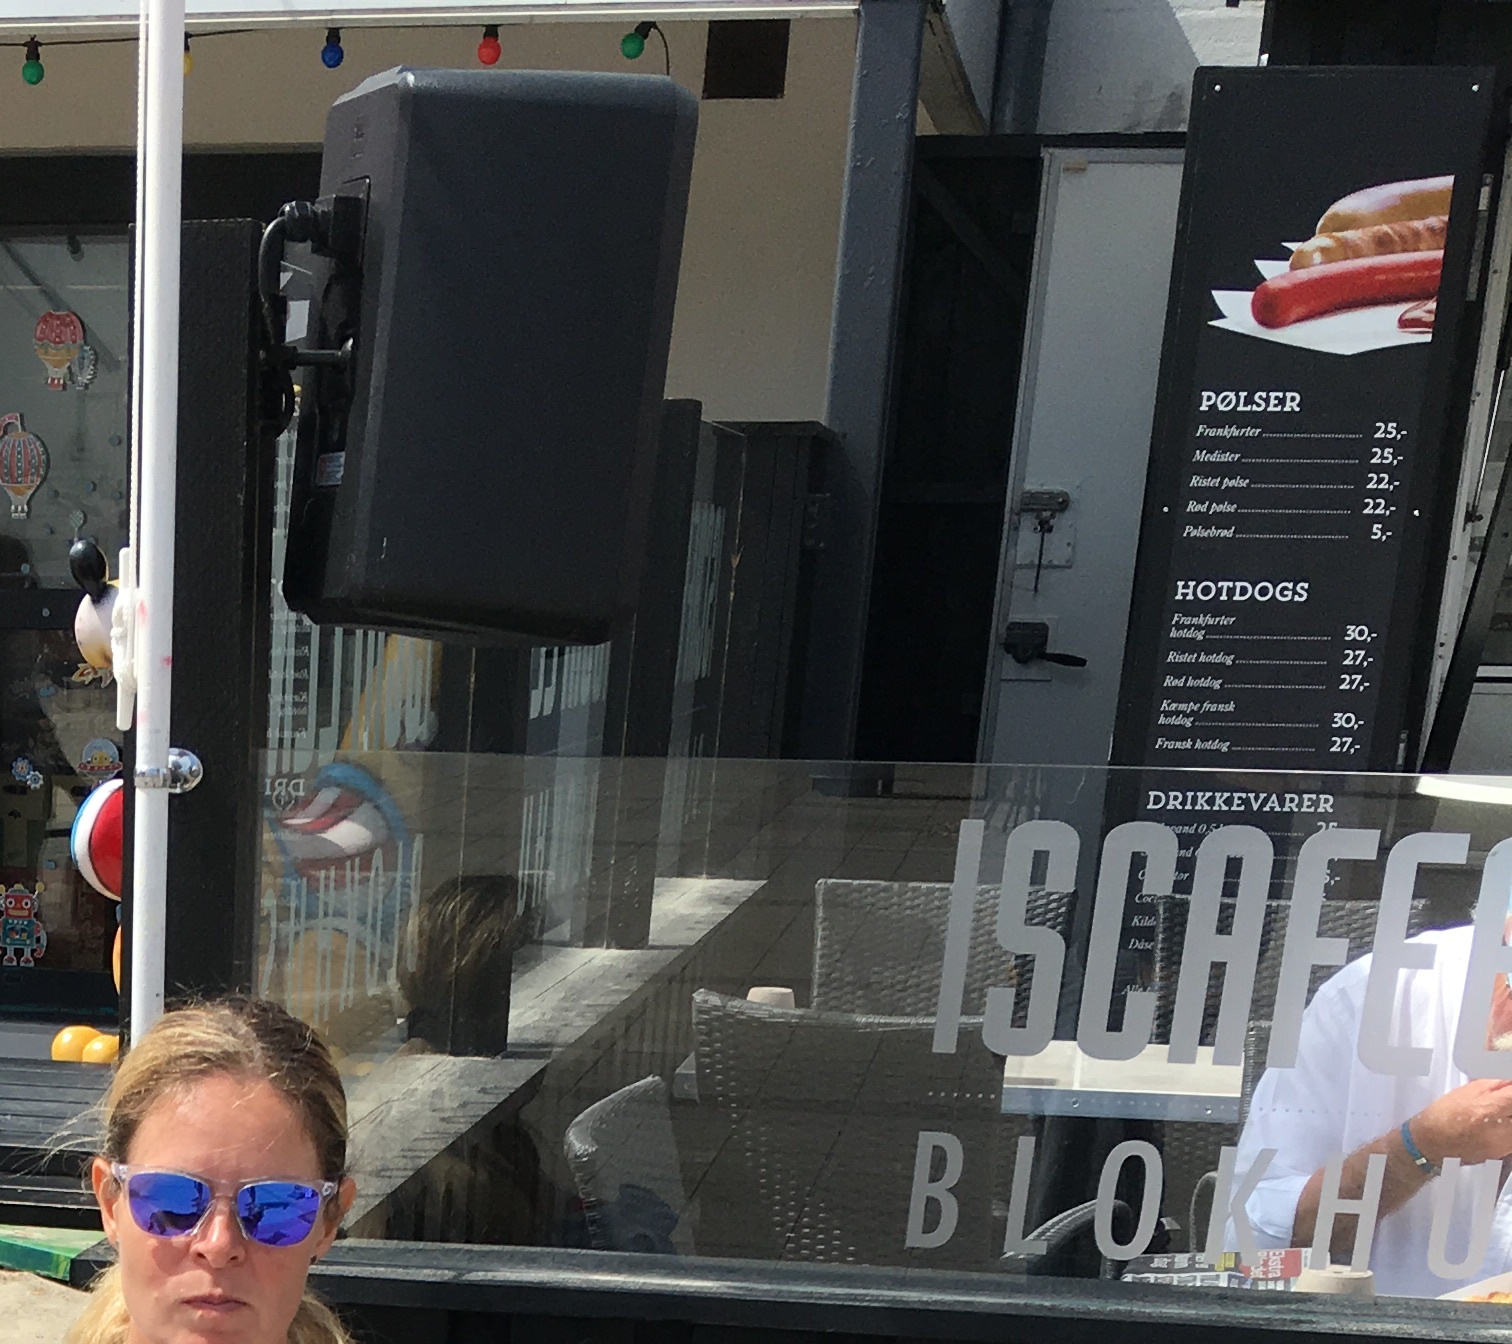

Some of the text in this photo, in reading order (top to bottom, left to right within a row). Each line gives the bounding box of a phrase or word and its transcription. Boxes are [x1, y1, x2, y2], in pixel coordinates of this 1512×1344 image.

[1199, 391, 1302, 412] PØLSER
[1195, 422, 1408, 441] Frankfurter 25,-
[1192, 448, 1404, 466] Medister 25,-
[1189, 473, 1400, 492] Ristet pølse 22,-
[1186, 499, 1396, 517] Rød pølse 22,-
[1183, 524, 1393, 542] Pølsebrød 5,-
[1174, 581, 1309, 602] HOTDOGS
[1171, 613, 1236, 627] Frankfurter
[1169, 625, 1378, 643] hotdog 30,-
[1166, 650, 1374, 668] Ristet hotdog 27,-
[1163, 674, 1371, 692] Rød hotdog 27,-
[1160, 700, 1236, 714] Kæmpe fransk
[1157, 712, 1365, 731] hotdog 30,-
[1155, 737, 1361, 755] Fransk hotdog 27,-
[1146, 791, 1335, 813] DRIKKEVARER
[905, 1131, 1502, 1280] BLOKHU
